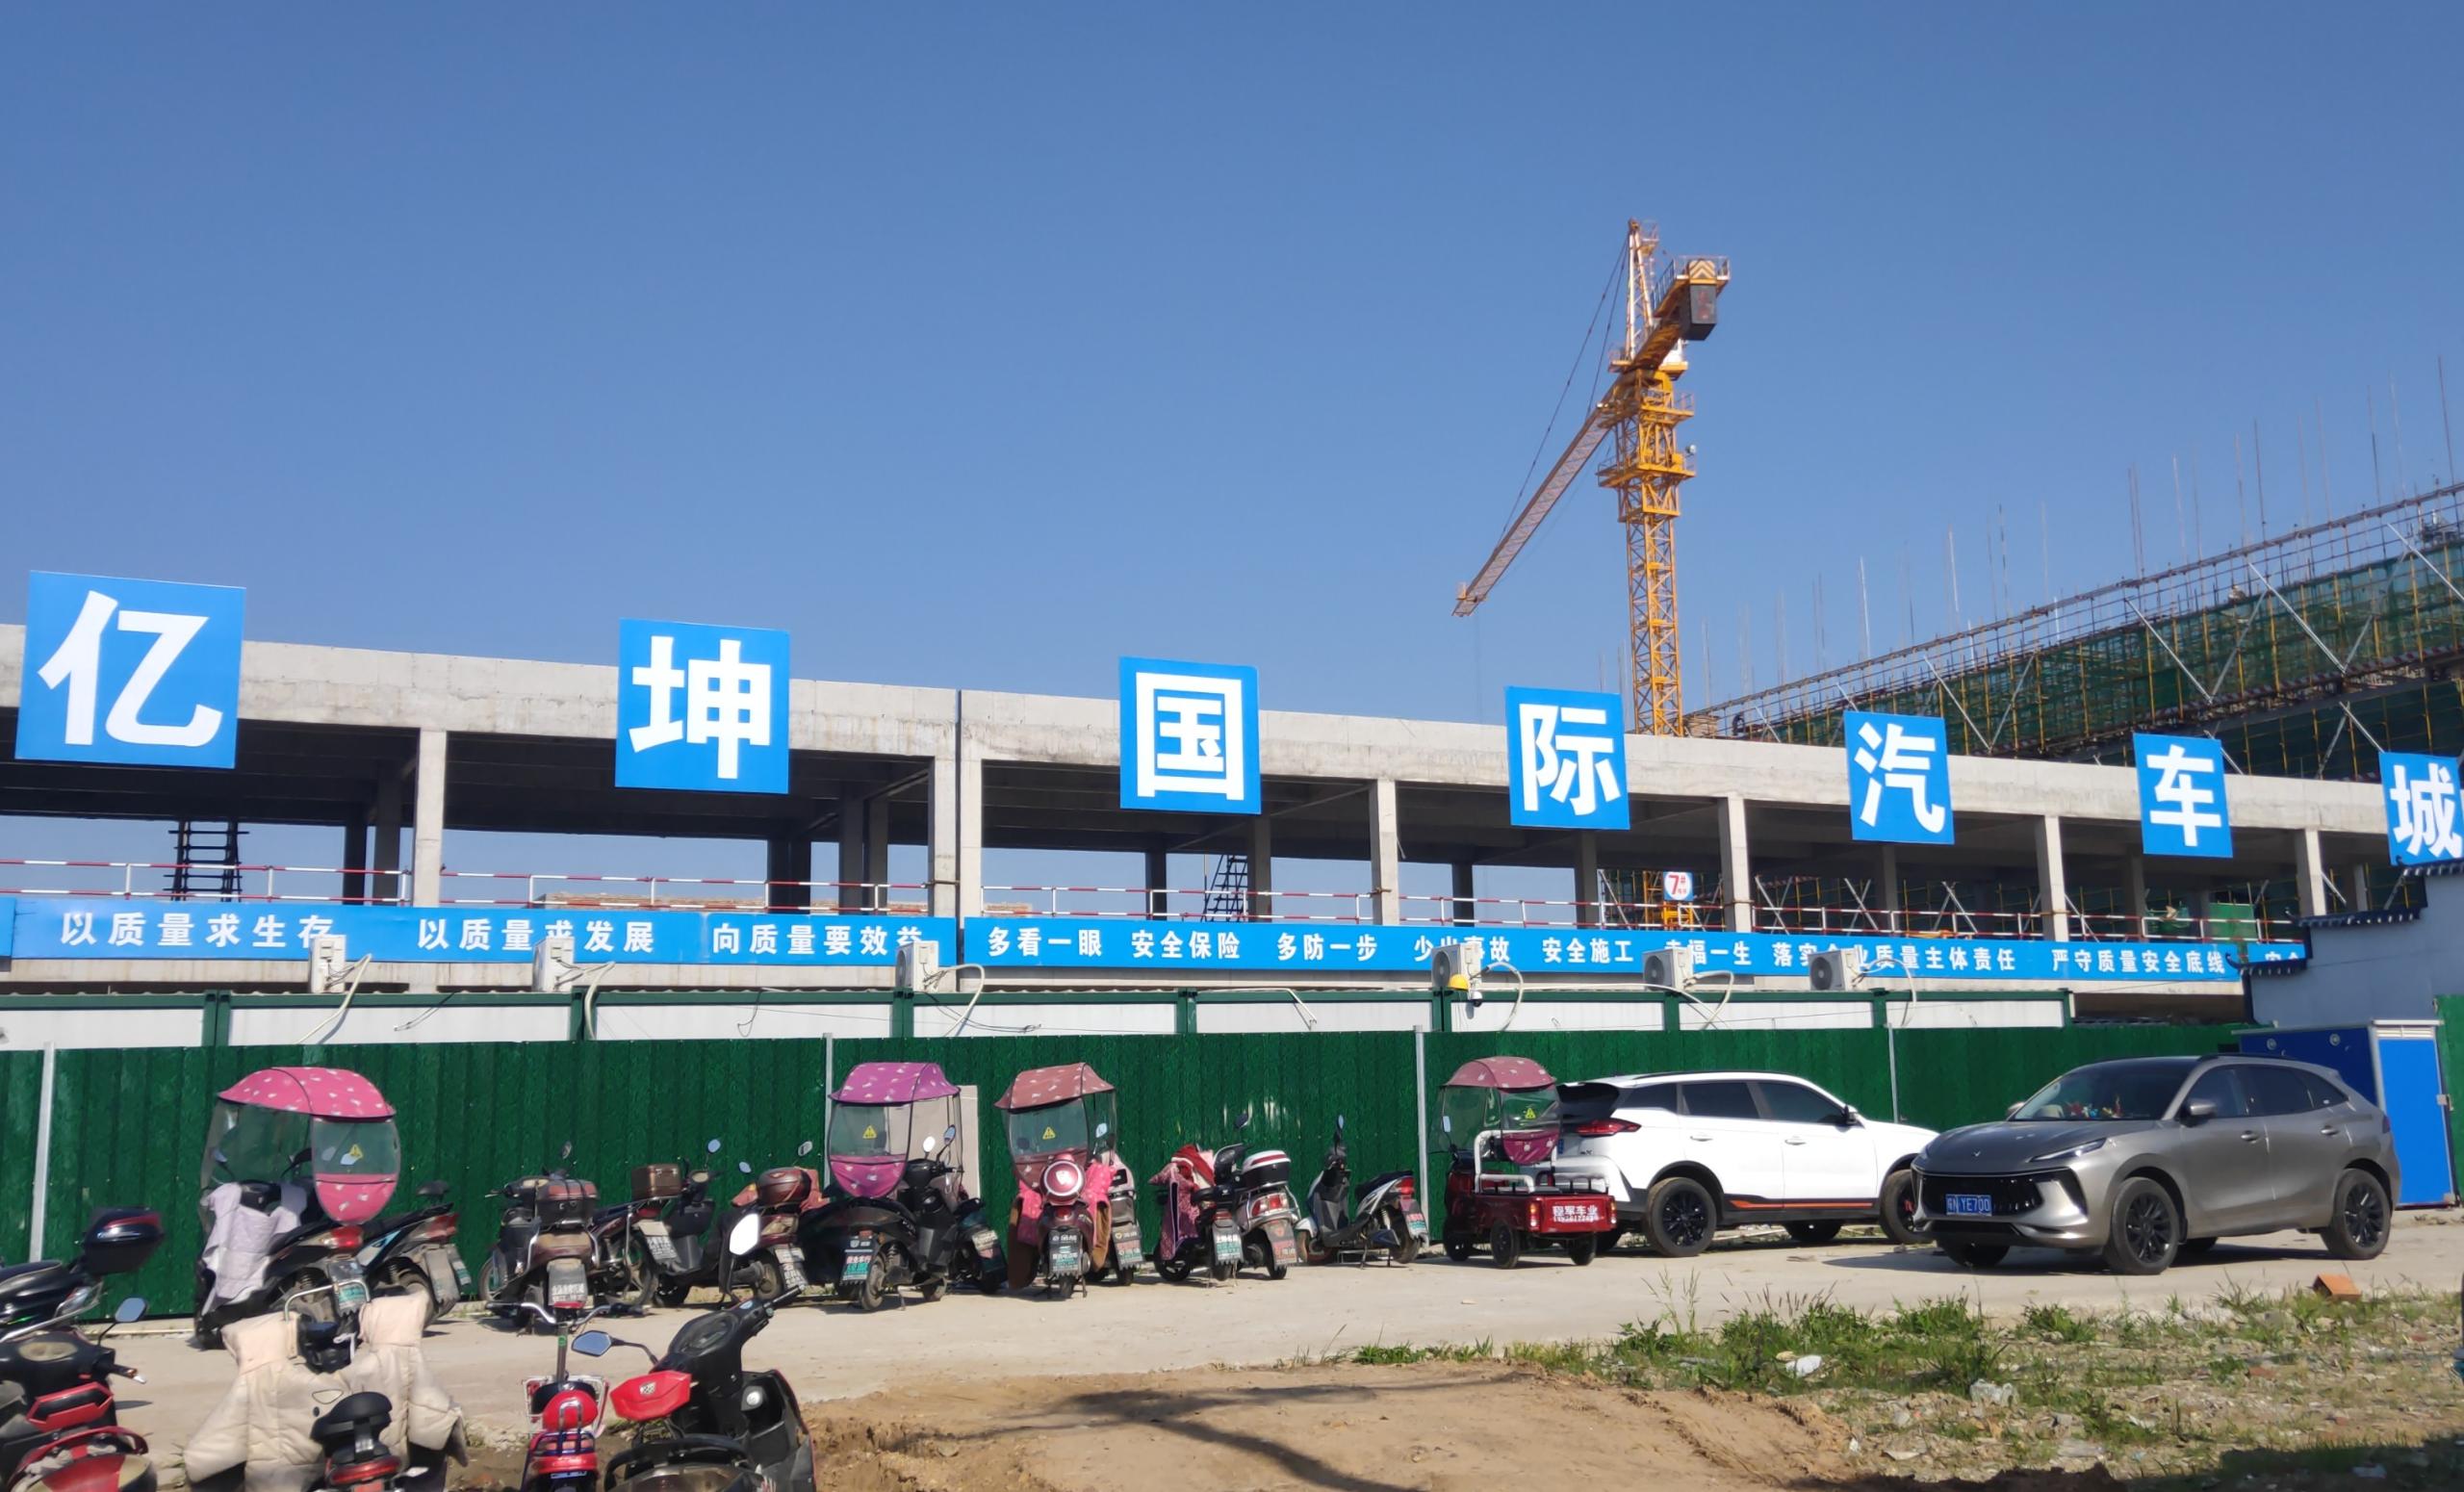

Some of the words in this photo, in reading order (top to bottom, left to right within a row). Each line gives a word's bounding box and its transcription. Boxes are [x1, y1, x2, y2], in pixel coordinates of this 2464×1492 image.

[38, 589, 222, 748] 亿
[628, 634, 773, 781] 坤
[1135, 671, 1248, 799] 国
[1518, 703, 1619, 816] 际
[1856, 724, 1946, 833] 汽
[2147, 745, 2222, 847] 车
[2389, 762, 2462, 858] 城
[60, 911, 334, 949] 以质量求生存
[417, 917, 654, 953] 以质量求发展
[713, 922, 923, 956] 向质量要效益
[988, 926, 1102, 957] 多看一眼
[1131, 930, 1241, 960] 安全保险
[1277, 933, 1377, 961] 多防一步
[1542, 938, 1633, 964] 安全施工
[1772, 941, 2015, 971] 落实业质量主体责任
[2052, 949, 2225, 974] 严守质量安全底线
